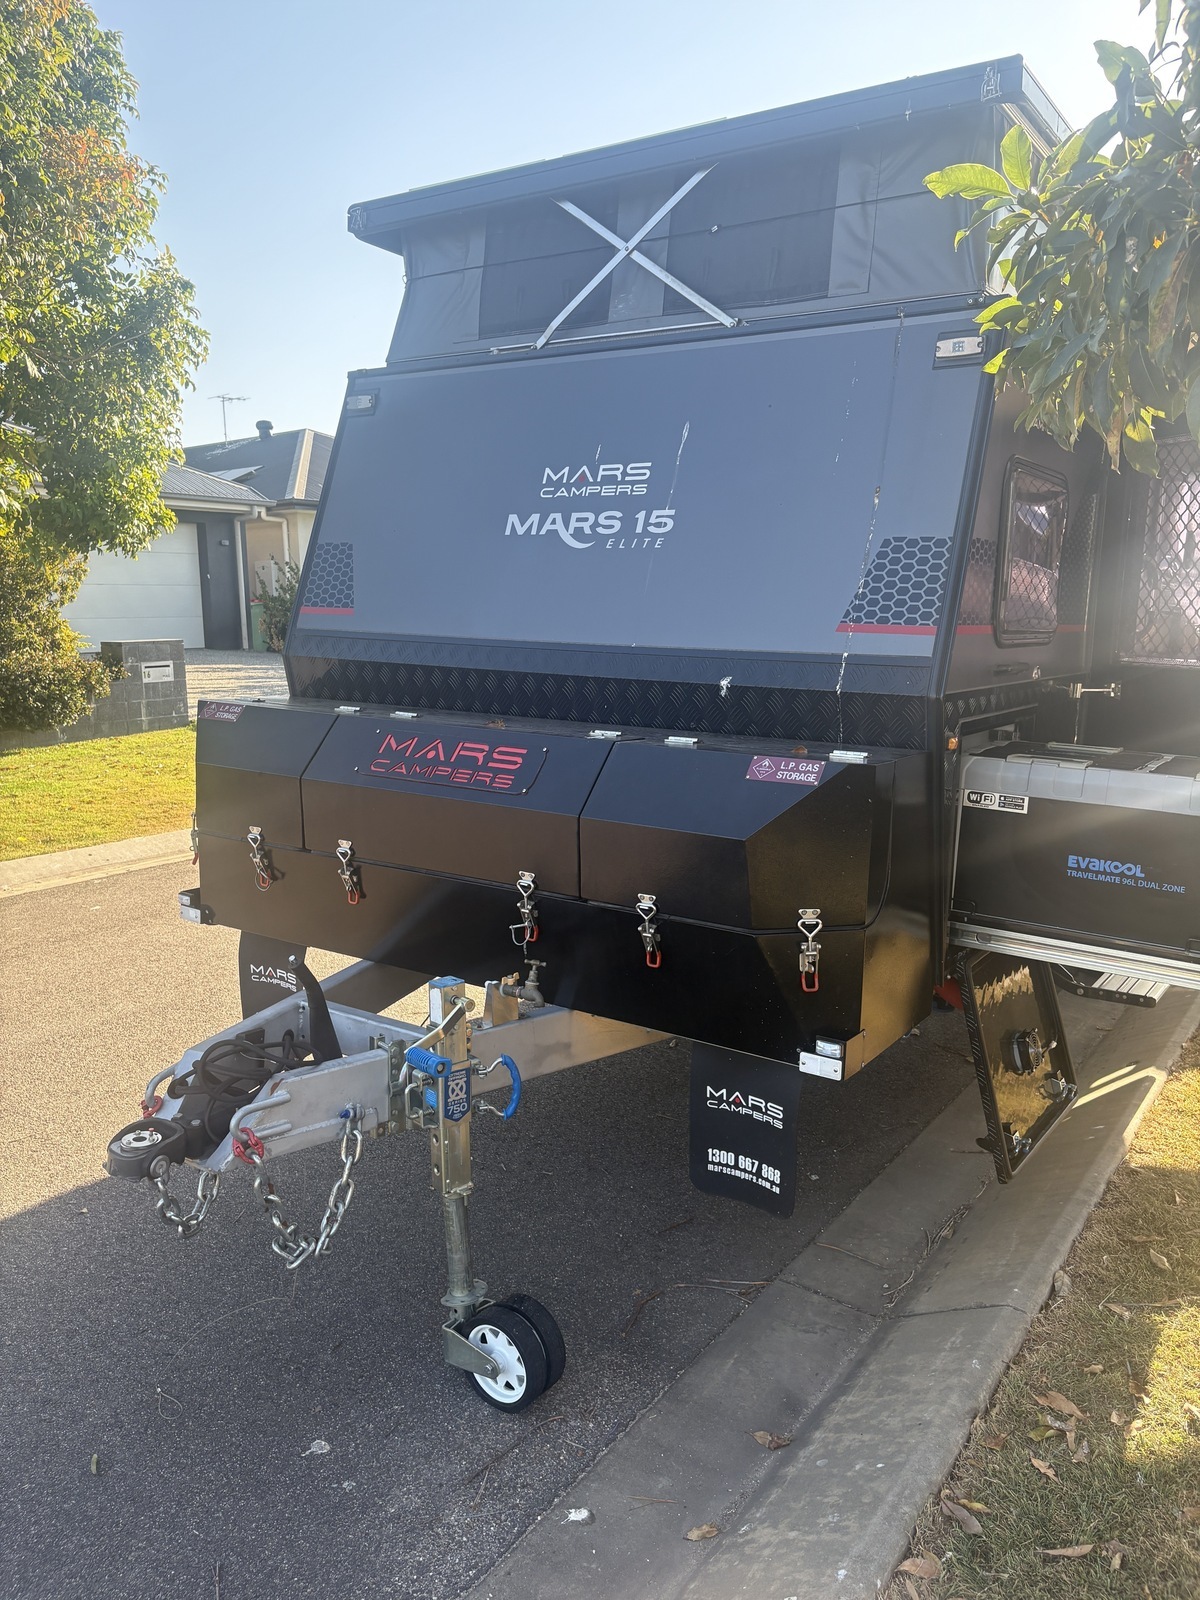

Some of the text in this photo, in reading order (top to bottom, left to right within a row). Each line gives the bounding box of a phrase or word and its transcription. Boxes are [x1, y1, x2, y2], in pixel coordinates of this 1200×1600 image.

[542, 462, 652, 484] MARS
[540, 484, 648, 498] CAMPERS
[504, 509, 676, 549] MARS 15
[605, 538, 665, 549] ELITE
[214, 711, 239, 720] STORAGE
[378, 733, 528, 770] MARS
[370, 759, 515, 789] CAMPERS
[776, 771, 818, 782] STORAGE
[780, 761, 820, 772] L.P. GAS
[1067, 869, 1186, 894] TRAVELMATE 96L DUAL ZONE
[250, 963, 297, 985] MARS
[251, 975, 297, 993] CAMPERS
[447, 1102, 468, 1116] 750
[706, 1085, 784, 1119] MARS
[706, 1100, 784, 1130] CAMPERS
[707, 1148, 781, 1184] 1300 667 868
[707, 1163, 780, 1195] marscampers.com.au
